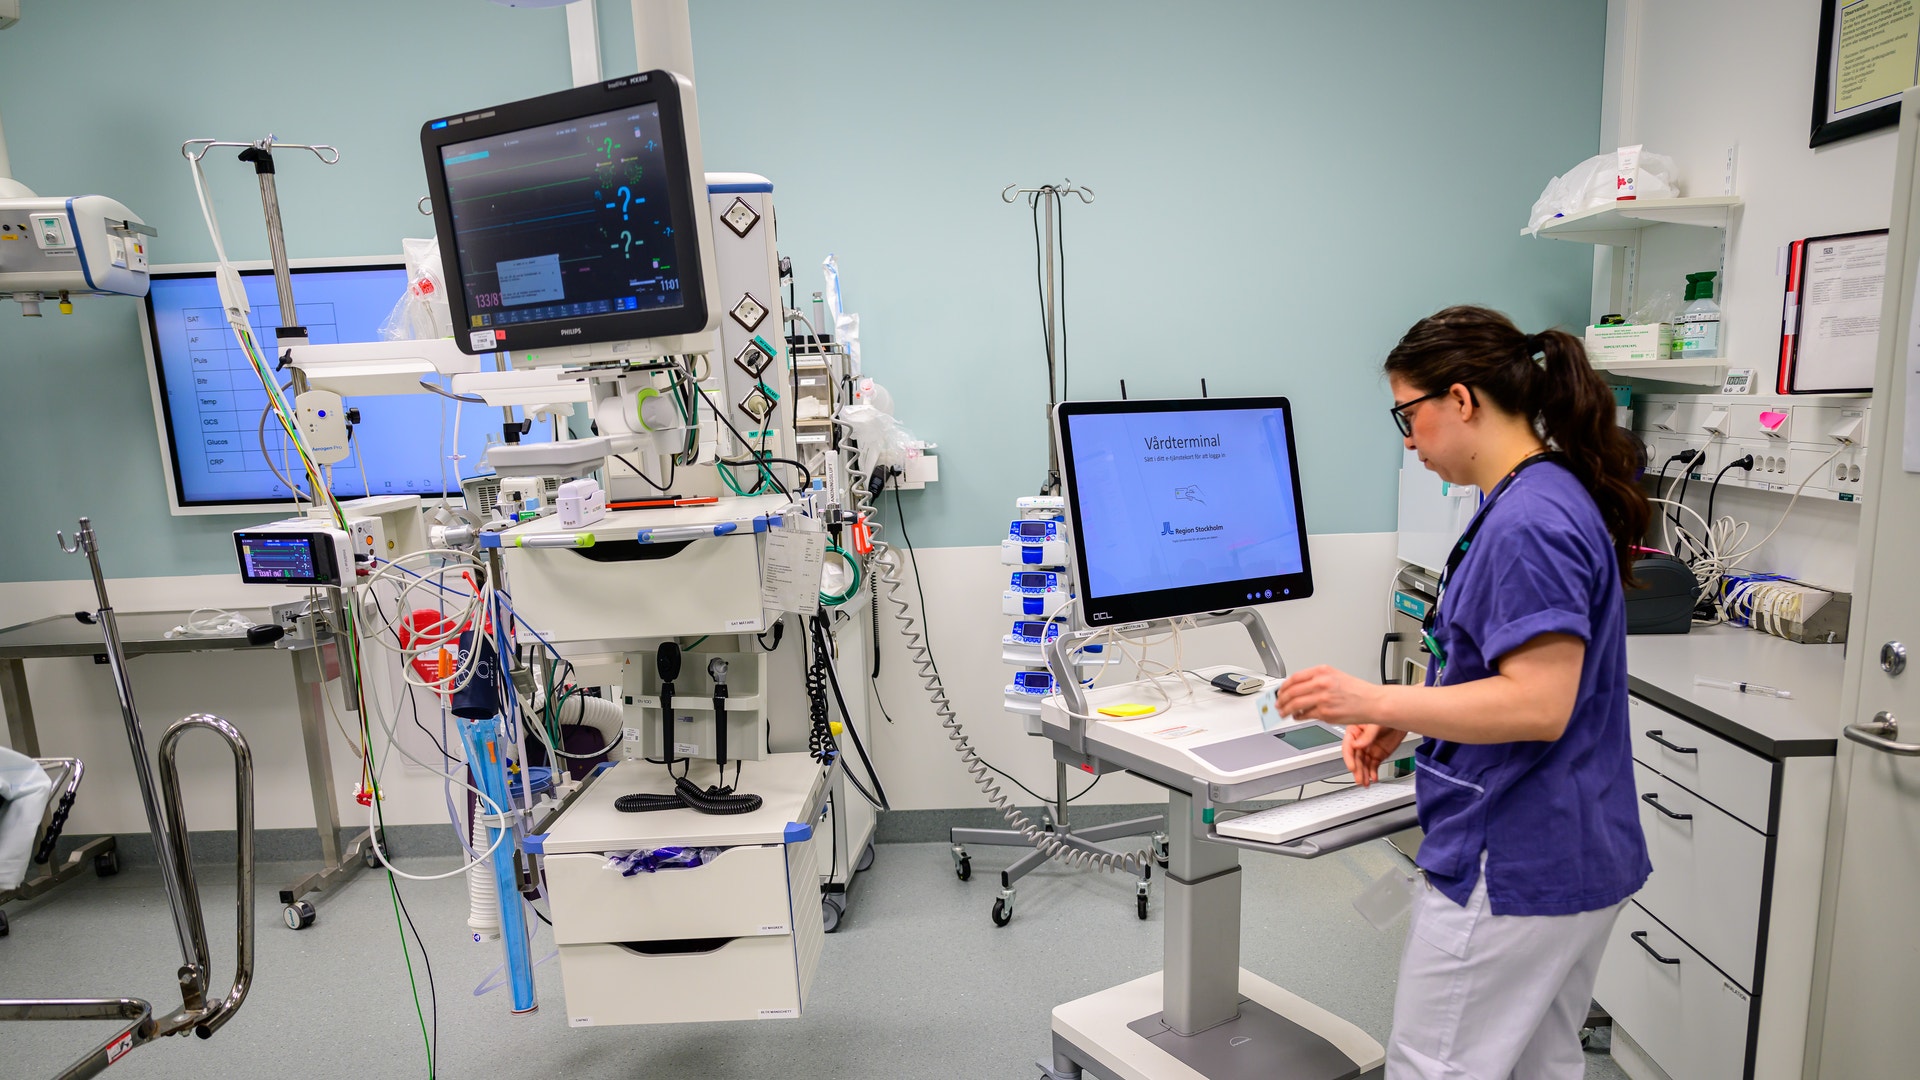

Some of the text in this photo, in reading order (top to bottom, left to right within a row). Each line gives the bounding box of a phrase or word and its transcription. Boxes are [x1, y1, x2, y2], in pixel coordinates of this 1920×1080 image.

[660, 278, 679, 291] 11:01
[561, 327, 581, 336] PHILIPS
[1144, 433, 1221, 450] Vårdterminal
[1165, 454, 1194, 462] e-tjänstekort
[1175, 524, 1223, 536] Region Stockholm
